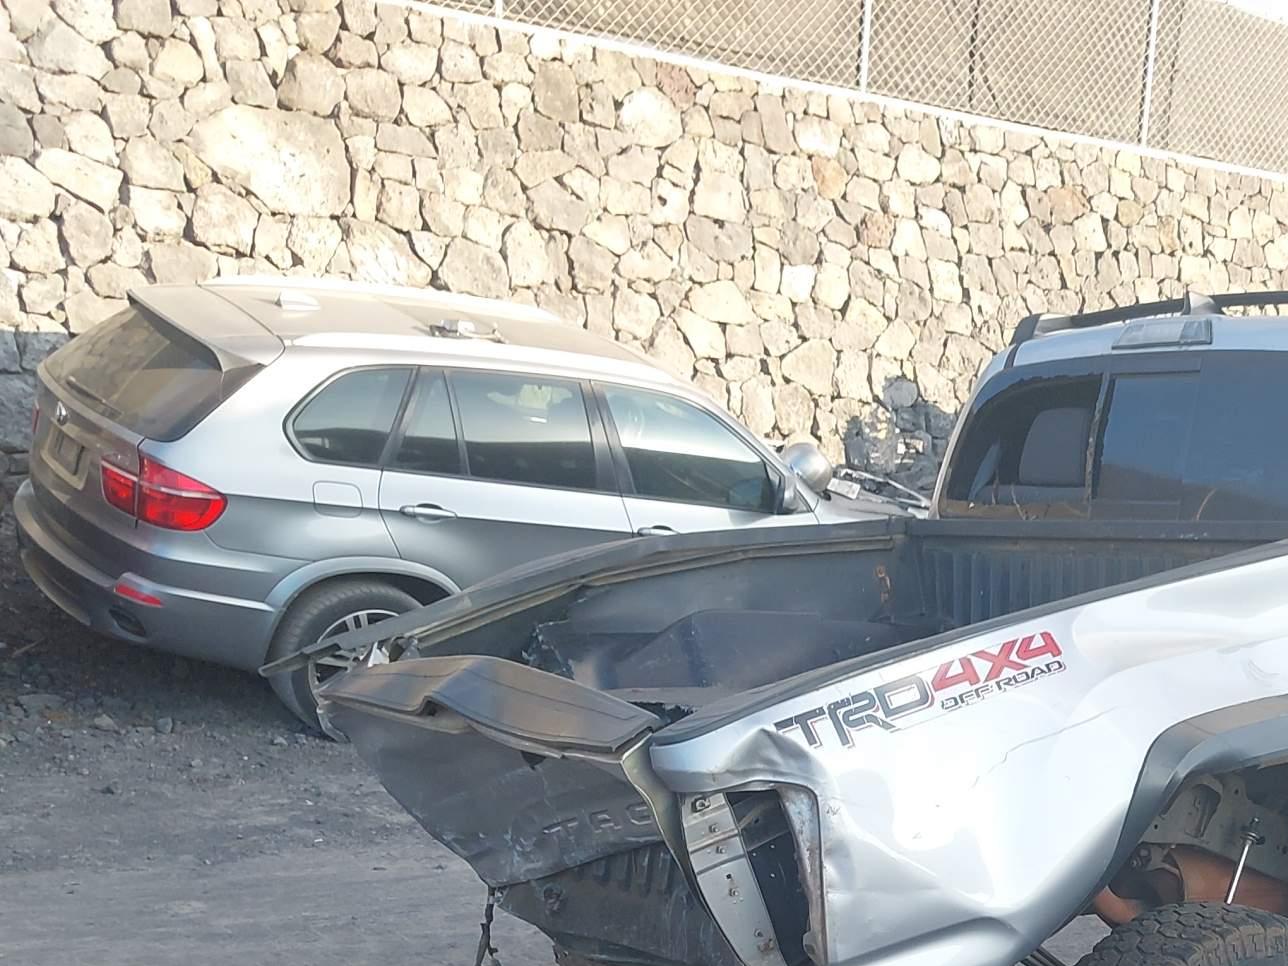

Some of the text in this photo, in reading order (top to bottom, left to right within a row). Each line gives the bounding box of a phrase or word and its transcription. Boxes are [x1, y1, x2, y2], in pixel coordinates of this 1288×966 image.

[773, 671, 936, 750] TRD
[940, 660, 1066, 711] OFF ROAD
